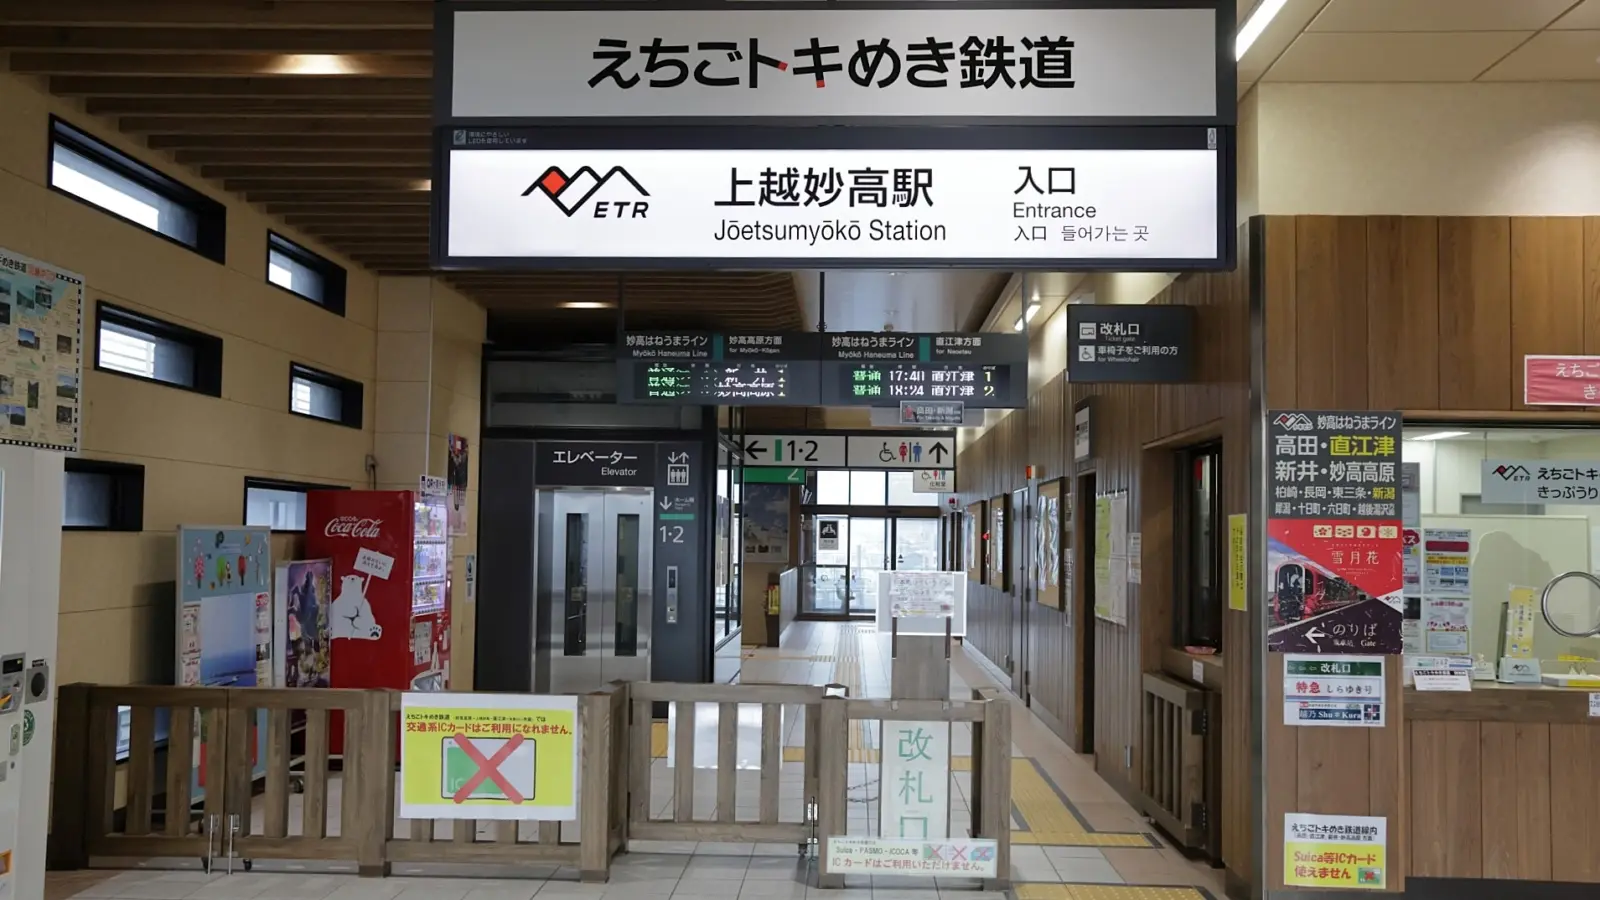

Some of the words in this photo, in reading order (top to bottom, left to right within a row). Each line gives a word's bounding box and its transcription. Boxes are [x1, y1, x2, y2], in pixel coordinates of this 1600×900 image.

[587, 36, 1076, 89] えちごトキめき鉄道
[1013, 165, 1077, 195] 入口
[714, 167, 935, 208] 上越妙高駅
[592, 201, 650, 219] ETR
[1013, 202, 1097, 219] Entrance
[714, 217, 862, 246] Jōetsumyōkō
[869, 218, 946, 241] Station
[1013, 225, 1048, 242] 入口
[1061, 225, 1130, 242] 들어가는
[1133, 225, 1150, 242] 곳
[1100, 322, 1140, 335] 改札口
[626, 335, 708, 346] 妙高はねうまライン
[728, 336, 782, 345] 妙高高原方面
[831, 336, 915, 348] 妙高はねうまライン
[935, 336, 982, 347] 直江津方面
[898, 351, 914, 359] Line
[1097, 346, 1178, 355] 車椅子をご利用の方
[931, 370, 975, 382] 直江津
[984, 371, 991, 382] 1
[931, 385, 975, 396] 直江津
[983, 386, 995, 397] 2
[1317, 415, 1396, 430] 妙高はねうまライン
[1275, 434, 1395, 456] 高田・直江津
[553, 450, 638, 464] エレベーター
[601, 466, 638, 476] Elevator
[1275, 460, 1395, 482] 新井・妙高高原
[1537, 467, 1600, 481] えちごトキ
[1275, 486, 1395, 500] 柏崎・長岡・東三条・新潟
[1537, 486, 1598, 500] きっぷうり
[325, 518, 383, 537] Coca-Cola
[1331, 550, 1380, 566] 雪月花
[1332, 623, 1378, 637] のりば
[1360, 639, 1376, 647] Gate
[1320, 663, 1351, 673] 改札口
[1296, 681, 1320, 694] 特急
[1327, 684, 1372, 694] しらゆき号
[406, 721, 573, 735] 交通系ICカードはご利用になれません。
[898, 727, 934, 840] 改札口
[1291, 823, 1378, 836] えちごトキめき鉄道線内
[1294, 850, 1376, 865] Suica等ICカード
[1294, 865, 1351, 880] 使えません
